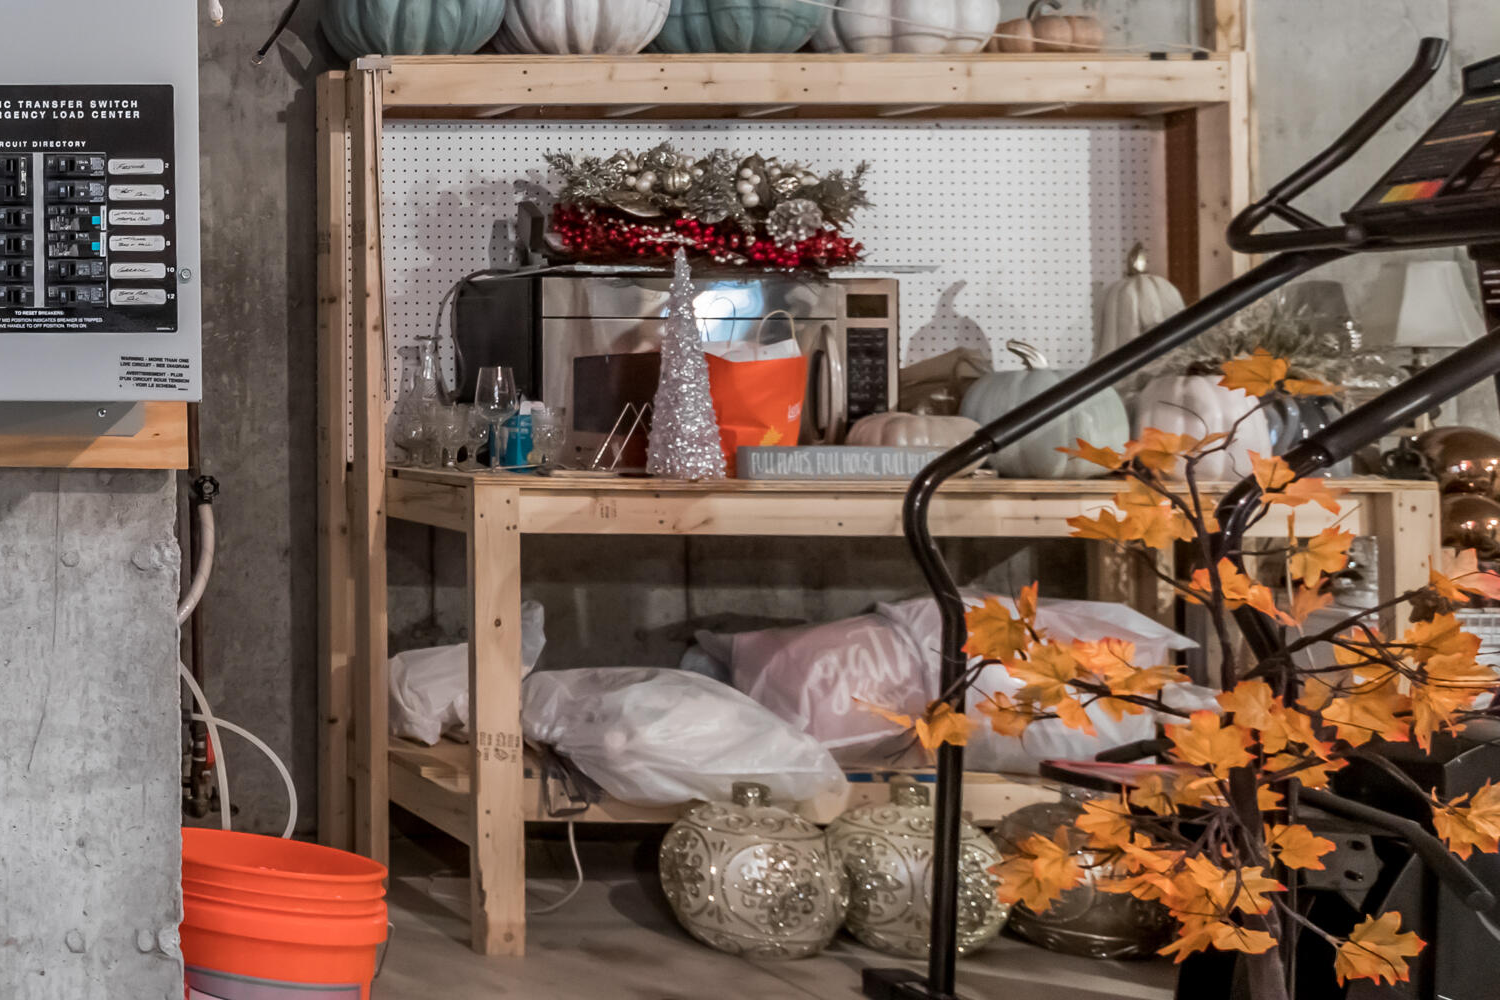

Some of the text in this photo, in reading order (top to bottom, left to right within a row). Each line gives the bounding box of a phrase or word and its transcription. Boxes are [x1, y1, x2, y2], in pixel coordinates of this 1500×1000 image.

[18, 100, 83, 108] TRANSFER
[90, 100, 138, 108] SWITCH
[52, 110, 84, 119] LOAD
[92, 110, 140, 119] CENTER
[752, 452, 774, 474] FULL
[816, 452, 840, 475] FULL
